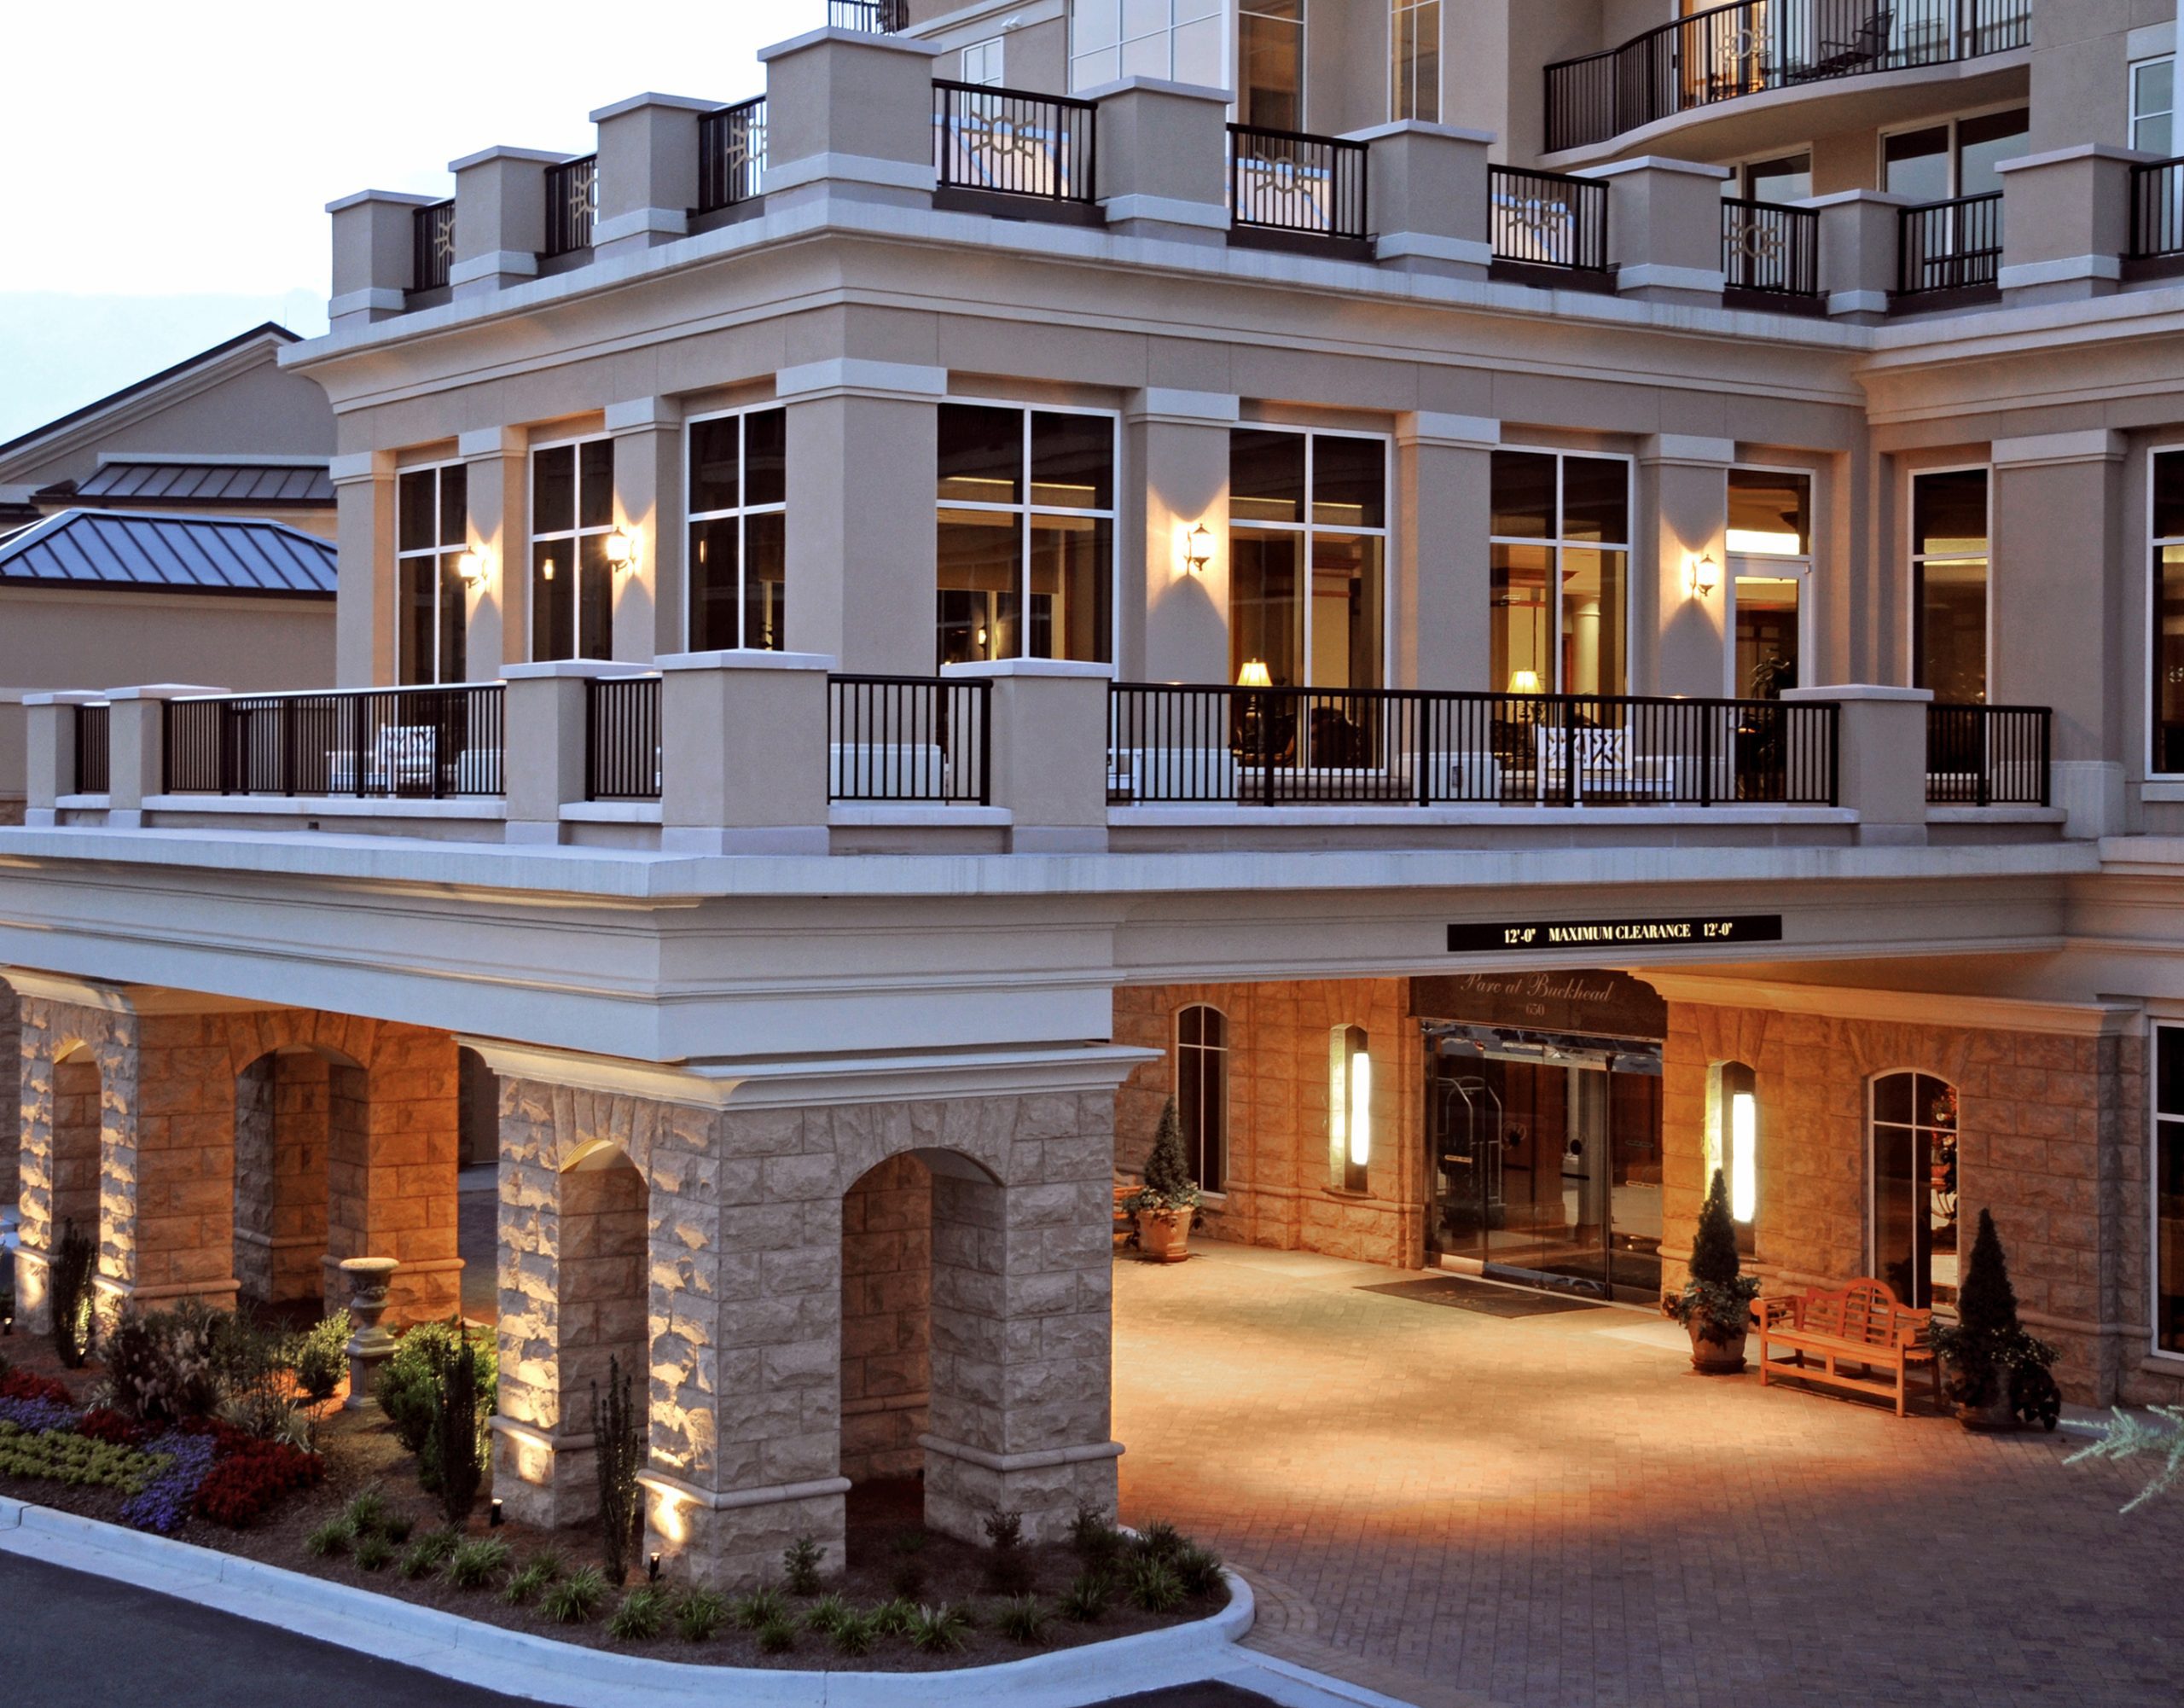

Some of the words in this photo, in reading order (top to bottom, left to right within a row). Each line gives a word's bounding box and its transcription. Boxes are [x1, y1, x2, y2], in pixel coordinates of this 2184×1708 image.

[1548, 926, 1612, 942] MAXIMUM
[1615, 924, 1691, 939] CLEARANCE
[1460, 973, 1502, 993] Parc
[1505, 979, 1523, 994] at
[1526, 973, 1614, 1002] Buckhead
[1525, 1002, 1545, 1016] 650
